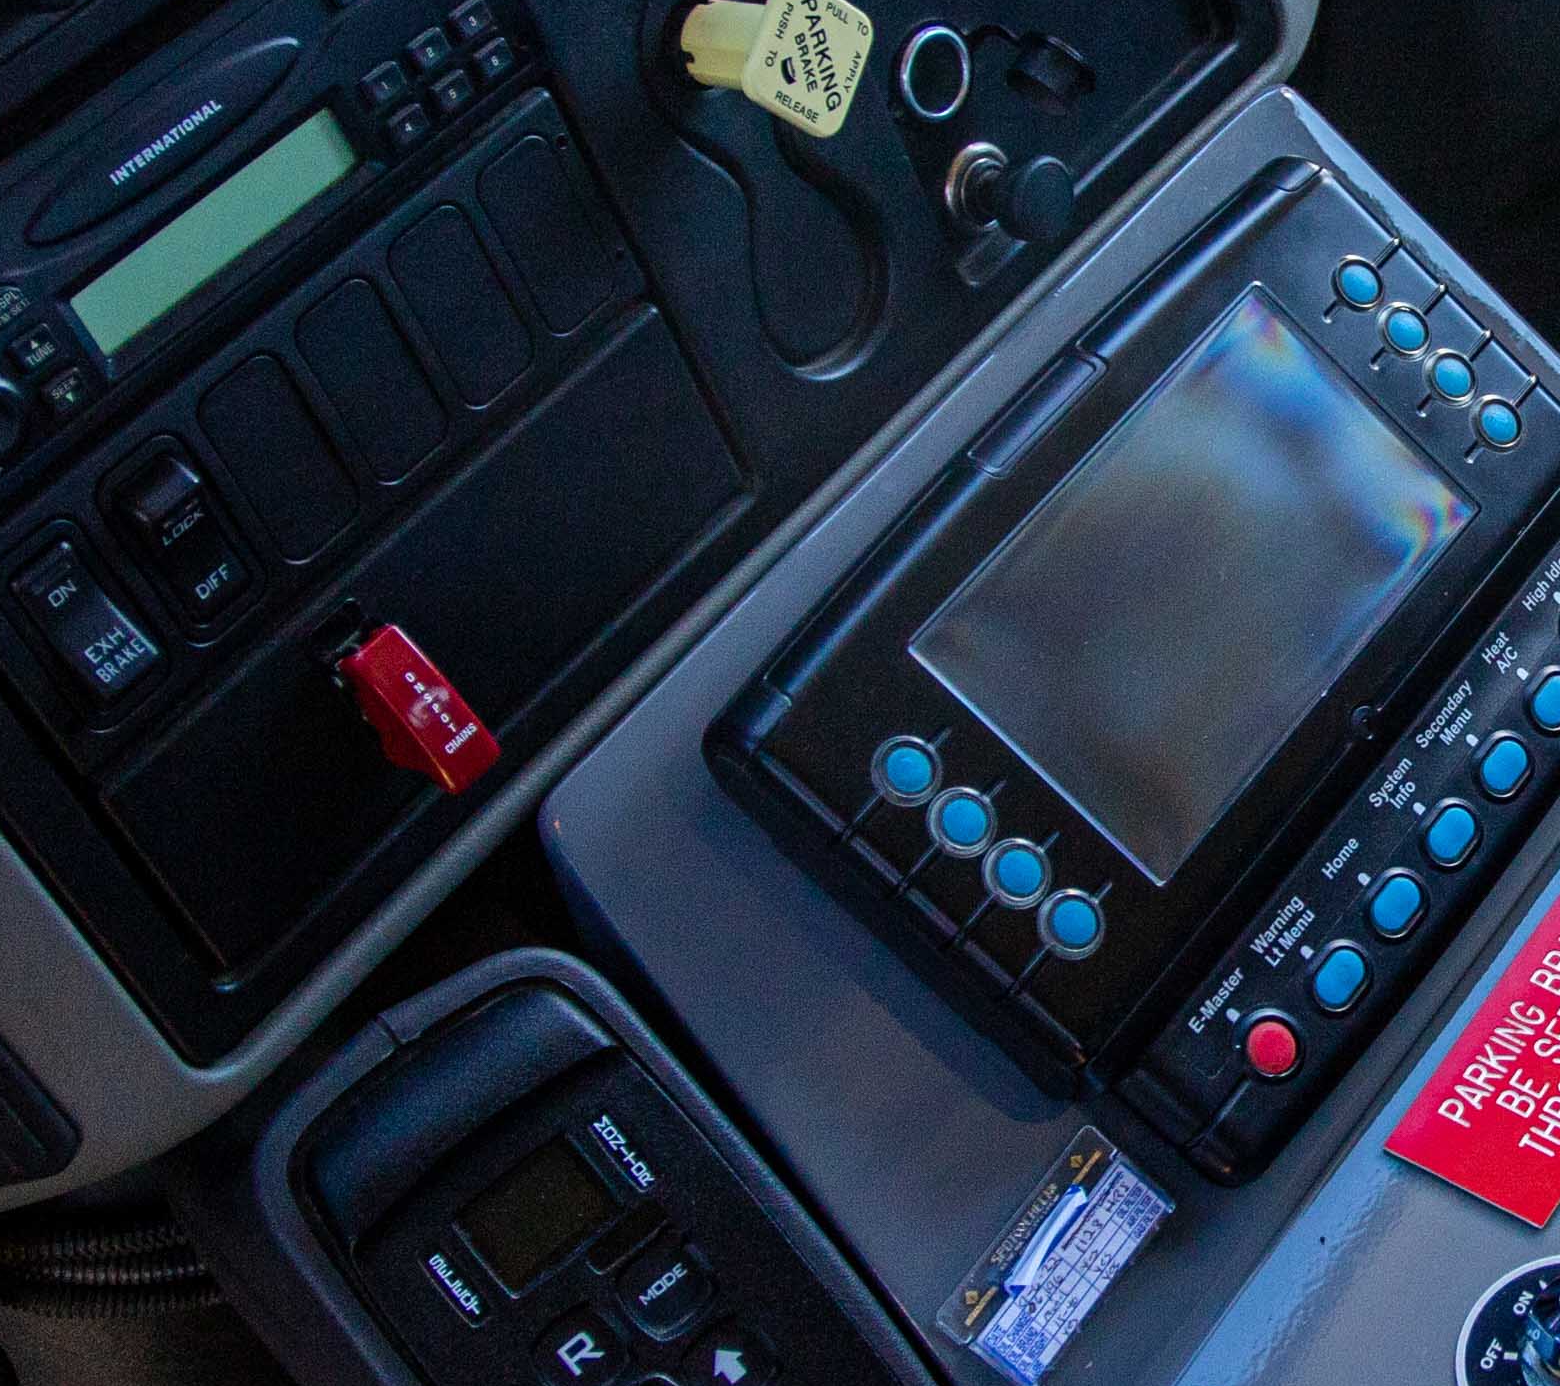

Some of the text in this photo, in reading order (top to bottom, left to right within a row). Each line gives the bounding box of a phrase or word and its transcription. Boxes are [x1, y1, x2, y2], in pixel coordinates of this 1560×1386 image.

[466, 15, 475, 28] 3
[426, 47, 435, 58] 2
[764, 2, 821, 124] PUSH TO RELEASE
[794, 31, 818, 94] BRAKE
[826, 1, 870, 95] PULL TO APPLY
[109, 100, 222, 186] INTERNATIONAL
[403, 122, 413, 133] 4
[26, 341, 57, 367] TUNE
[161, 508, 204, 548] LOCK
[47, 580, 78, 608] ON
[194, 563, 230, 601] DIFF
[1521, 579, 1550, 613] High
[83, 623, 127, 666] EXH
[95, 639, 147, 684] BRAKE
[1480, 630, 1510, 666] Heat
[1496, 646, 1519, 674] A/C
[1415, 679, 1473, 750] Secondary
[1439, 709, 1473, 746] Menu
[444, 722, 478, 755] CHAINS
[1368, 756, 1413, 809] System
[1389, 780, 1417, 810] Info
[1321, 836, 1359, 882] Home
[1249, 893, 1305, 956] Warning
[1263, 908, 1316, 969] Lt Menu
[1188, 967, 1245, 1034] E-Master
[1438, 999, 1546, 1128] PARKING
[1495, 1068, 1550, 1119] BE
[592, 1113, 656, 1188] MONITOR
[638, 1262, 689, 1306] MODE
[1512, 1289, 1535, 1316] ON
[555, 1331, 606, 1377] R
[1480, 1337, 1503, 1371] OFF
